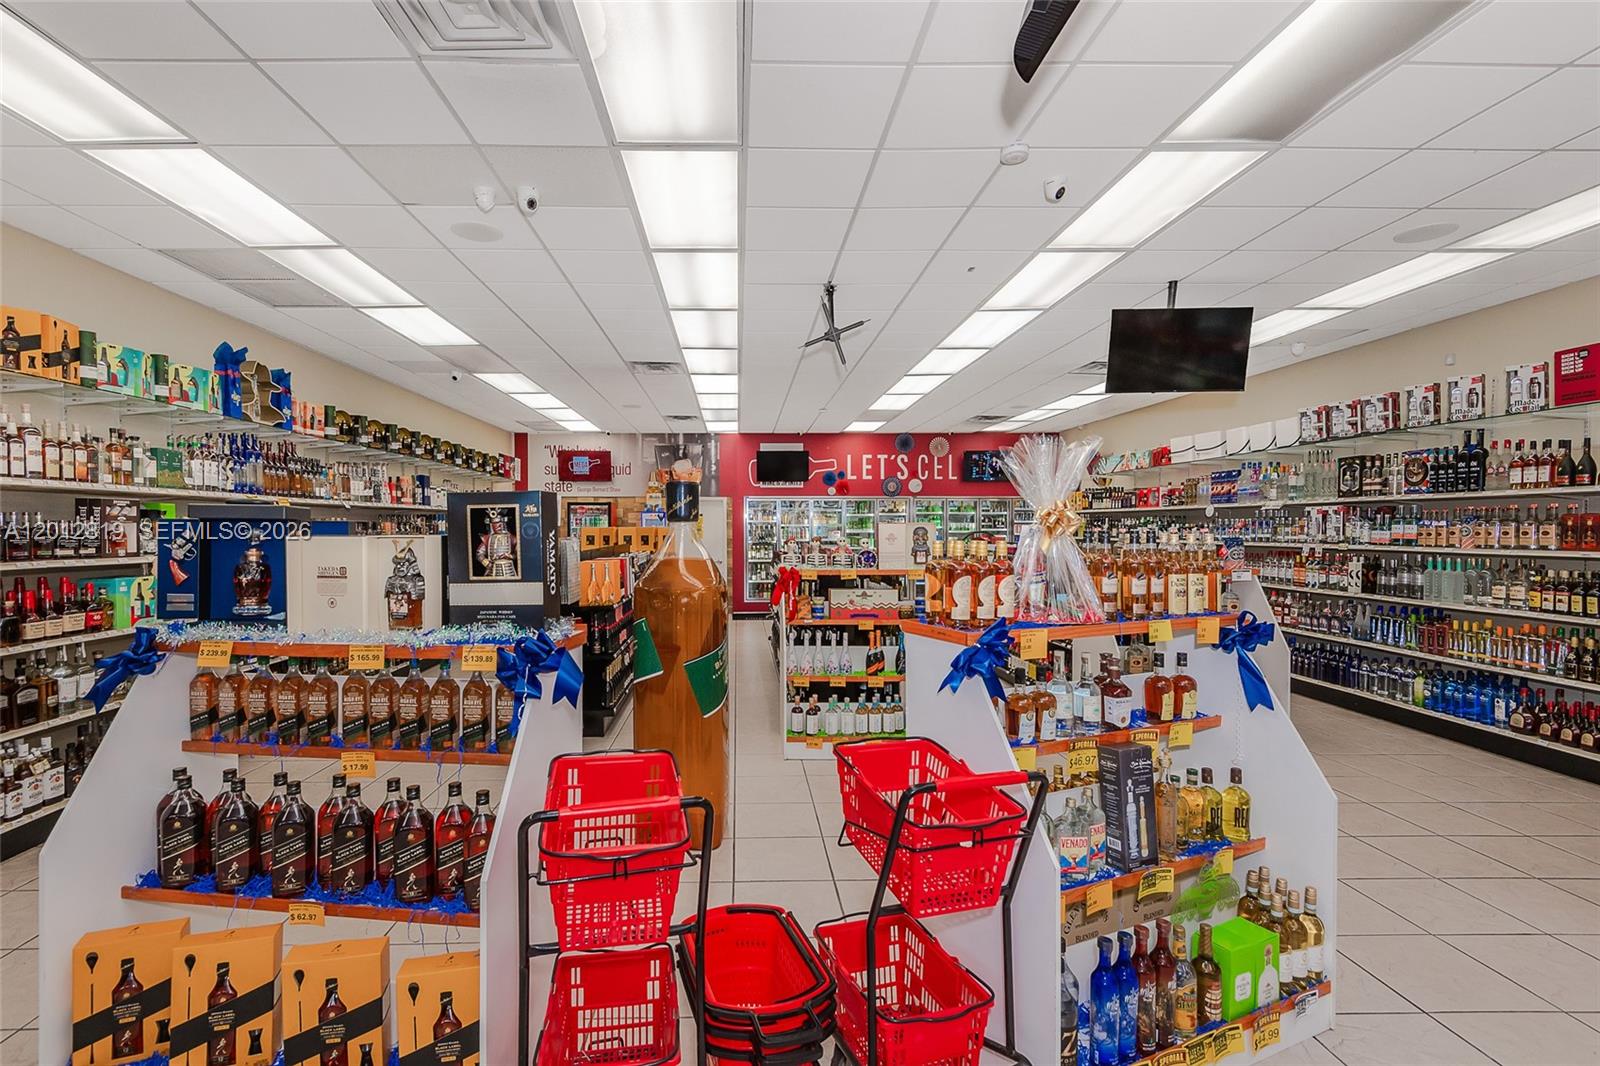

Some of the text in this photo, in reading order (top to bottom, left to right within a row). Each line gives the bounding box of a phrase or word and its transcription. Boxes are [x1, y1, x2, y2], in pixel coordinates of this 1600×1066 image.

[847, 454, 910, 481] LET'S
[544, 481, 573, 493] state
[549, 529, 557, 596] YAMATO
[200, 649, 205, 657] $
[1069, 755, 1097, 769] $46.97
[1061, 838, 1088, 848] VENADO
[1075, 930, 1099, 943] BLENDED
[1159, 1052, 1184, 1065] SPECIAL
